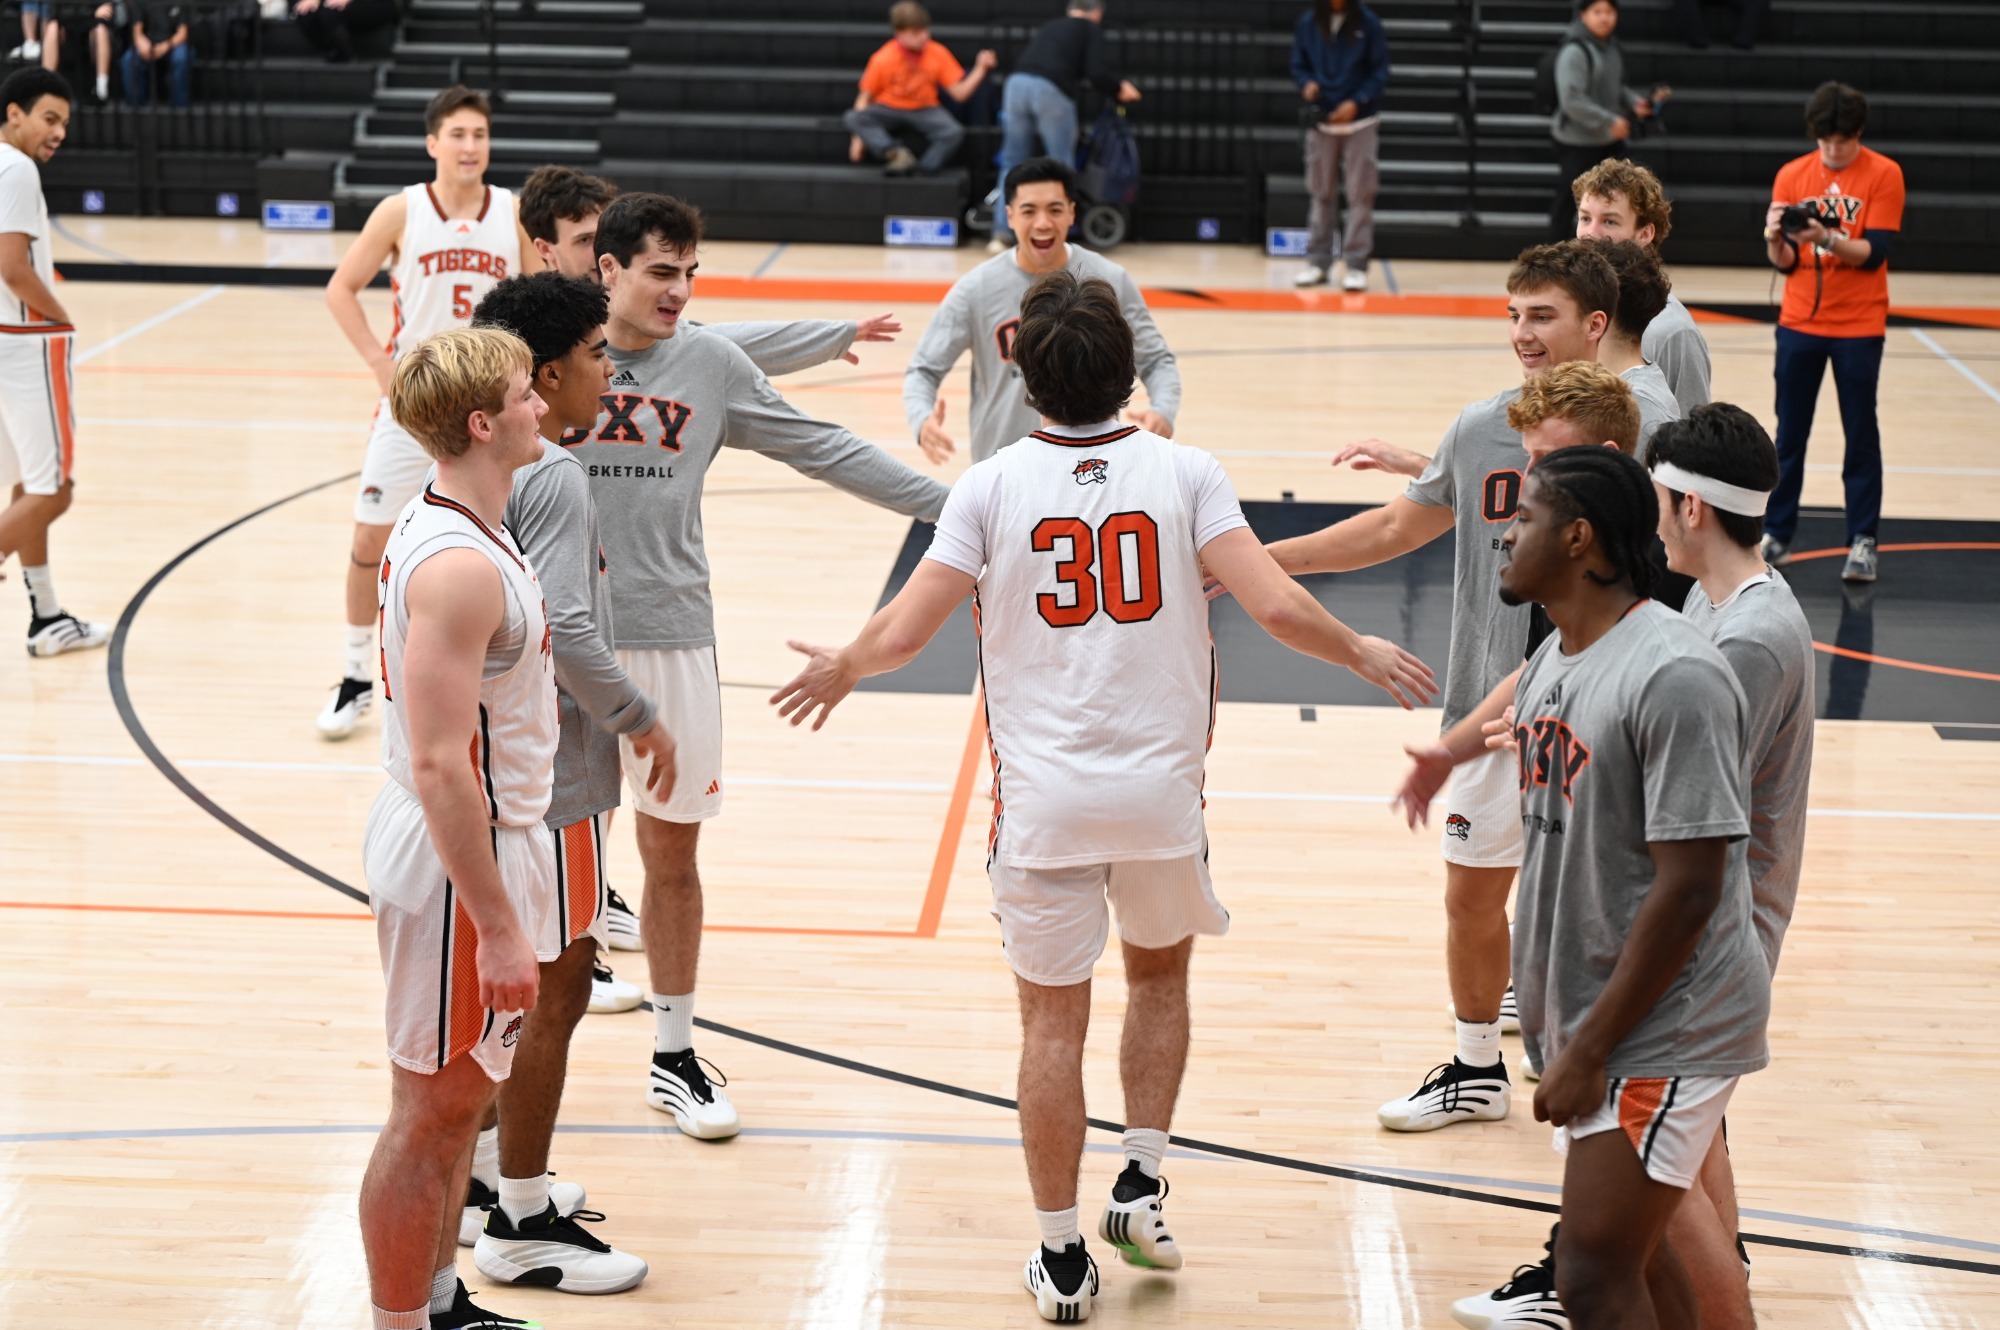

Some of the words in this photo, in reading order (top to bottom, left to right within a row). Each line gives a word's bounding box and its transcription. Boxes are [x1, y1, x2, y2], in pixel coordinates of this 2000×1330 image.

[1801, 195, 1863, 224] XY
[418, 247, 507, 280] TIGERS
[453, 285, 473, 319] 5
[612, 379, 640, 387] adidas
[558, 392, 693, 453] XY
[588, 464, 674, 478] SKETBALL
[1031, 510, 1162, 628] 30
